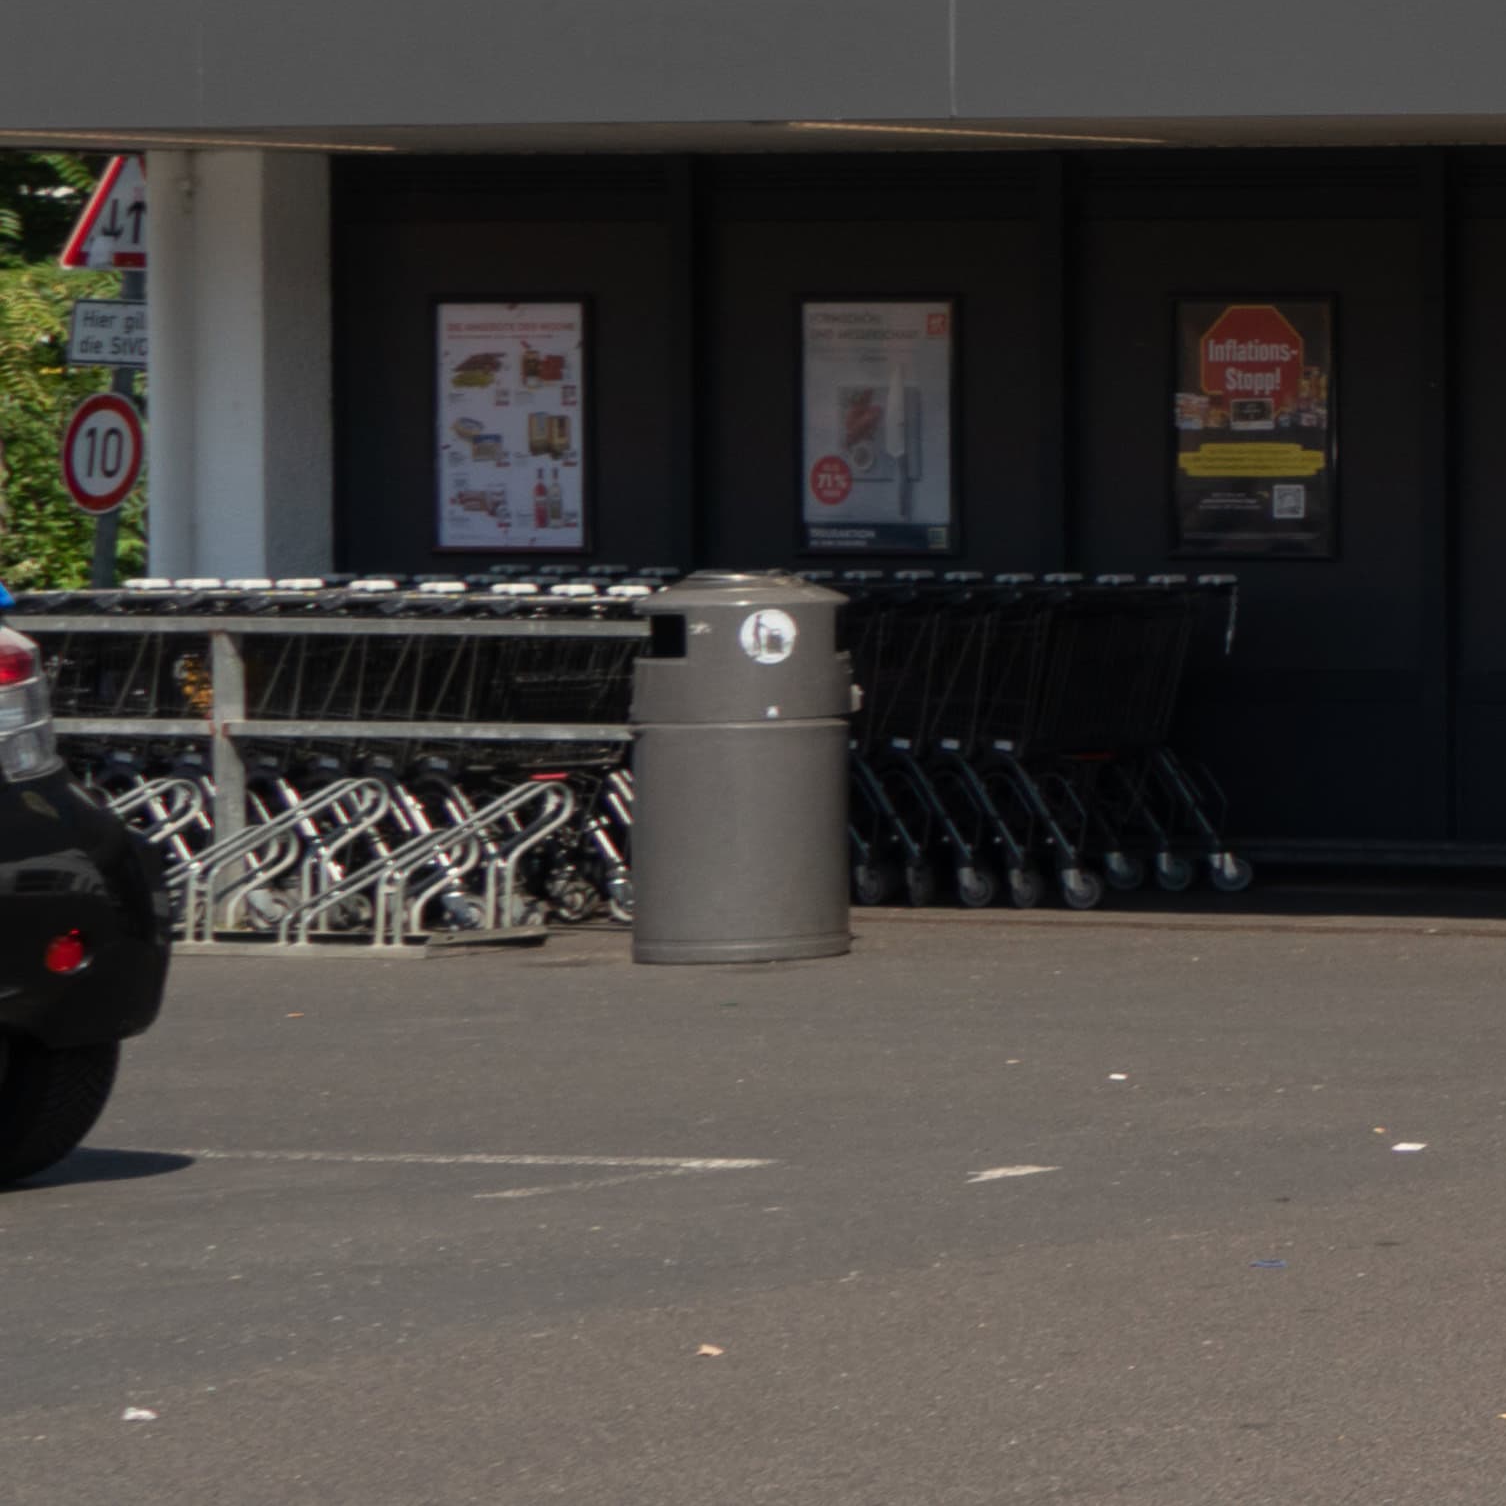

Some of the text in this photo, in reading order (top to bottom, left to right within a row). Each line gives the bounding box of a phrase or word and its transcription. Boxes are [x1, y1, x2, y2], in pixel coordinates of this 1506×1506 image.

[83, 310, 147, 334] Hier gil
[80, 335, 103, 354] die
[1207, 339, 1299, 362] Inflations-
[1225, 367, 1281, 395] Stopp!
[85, 427, 124, 479] 10
